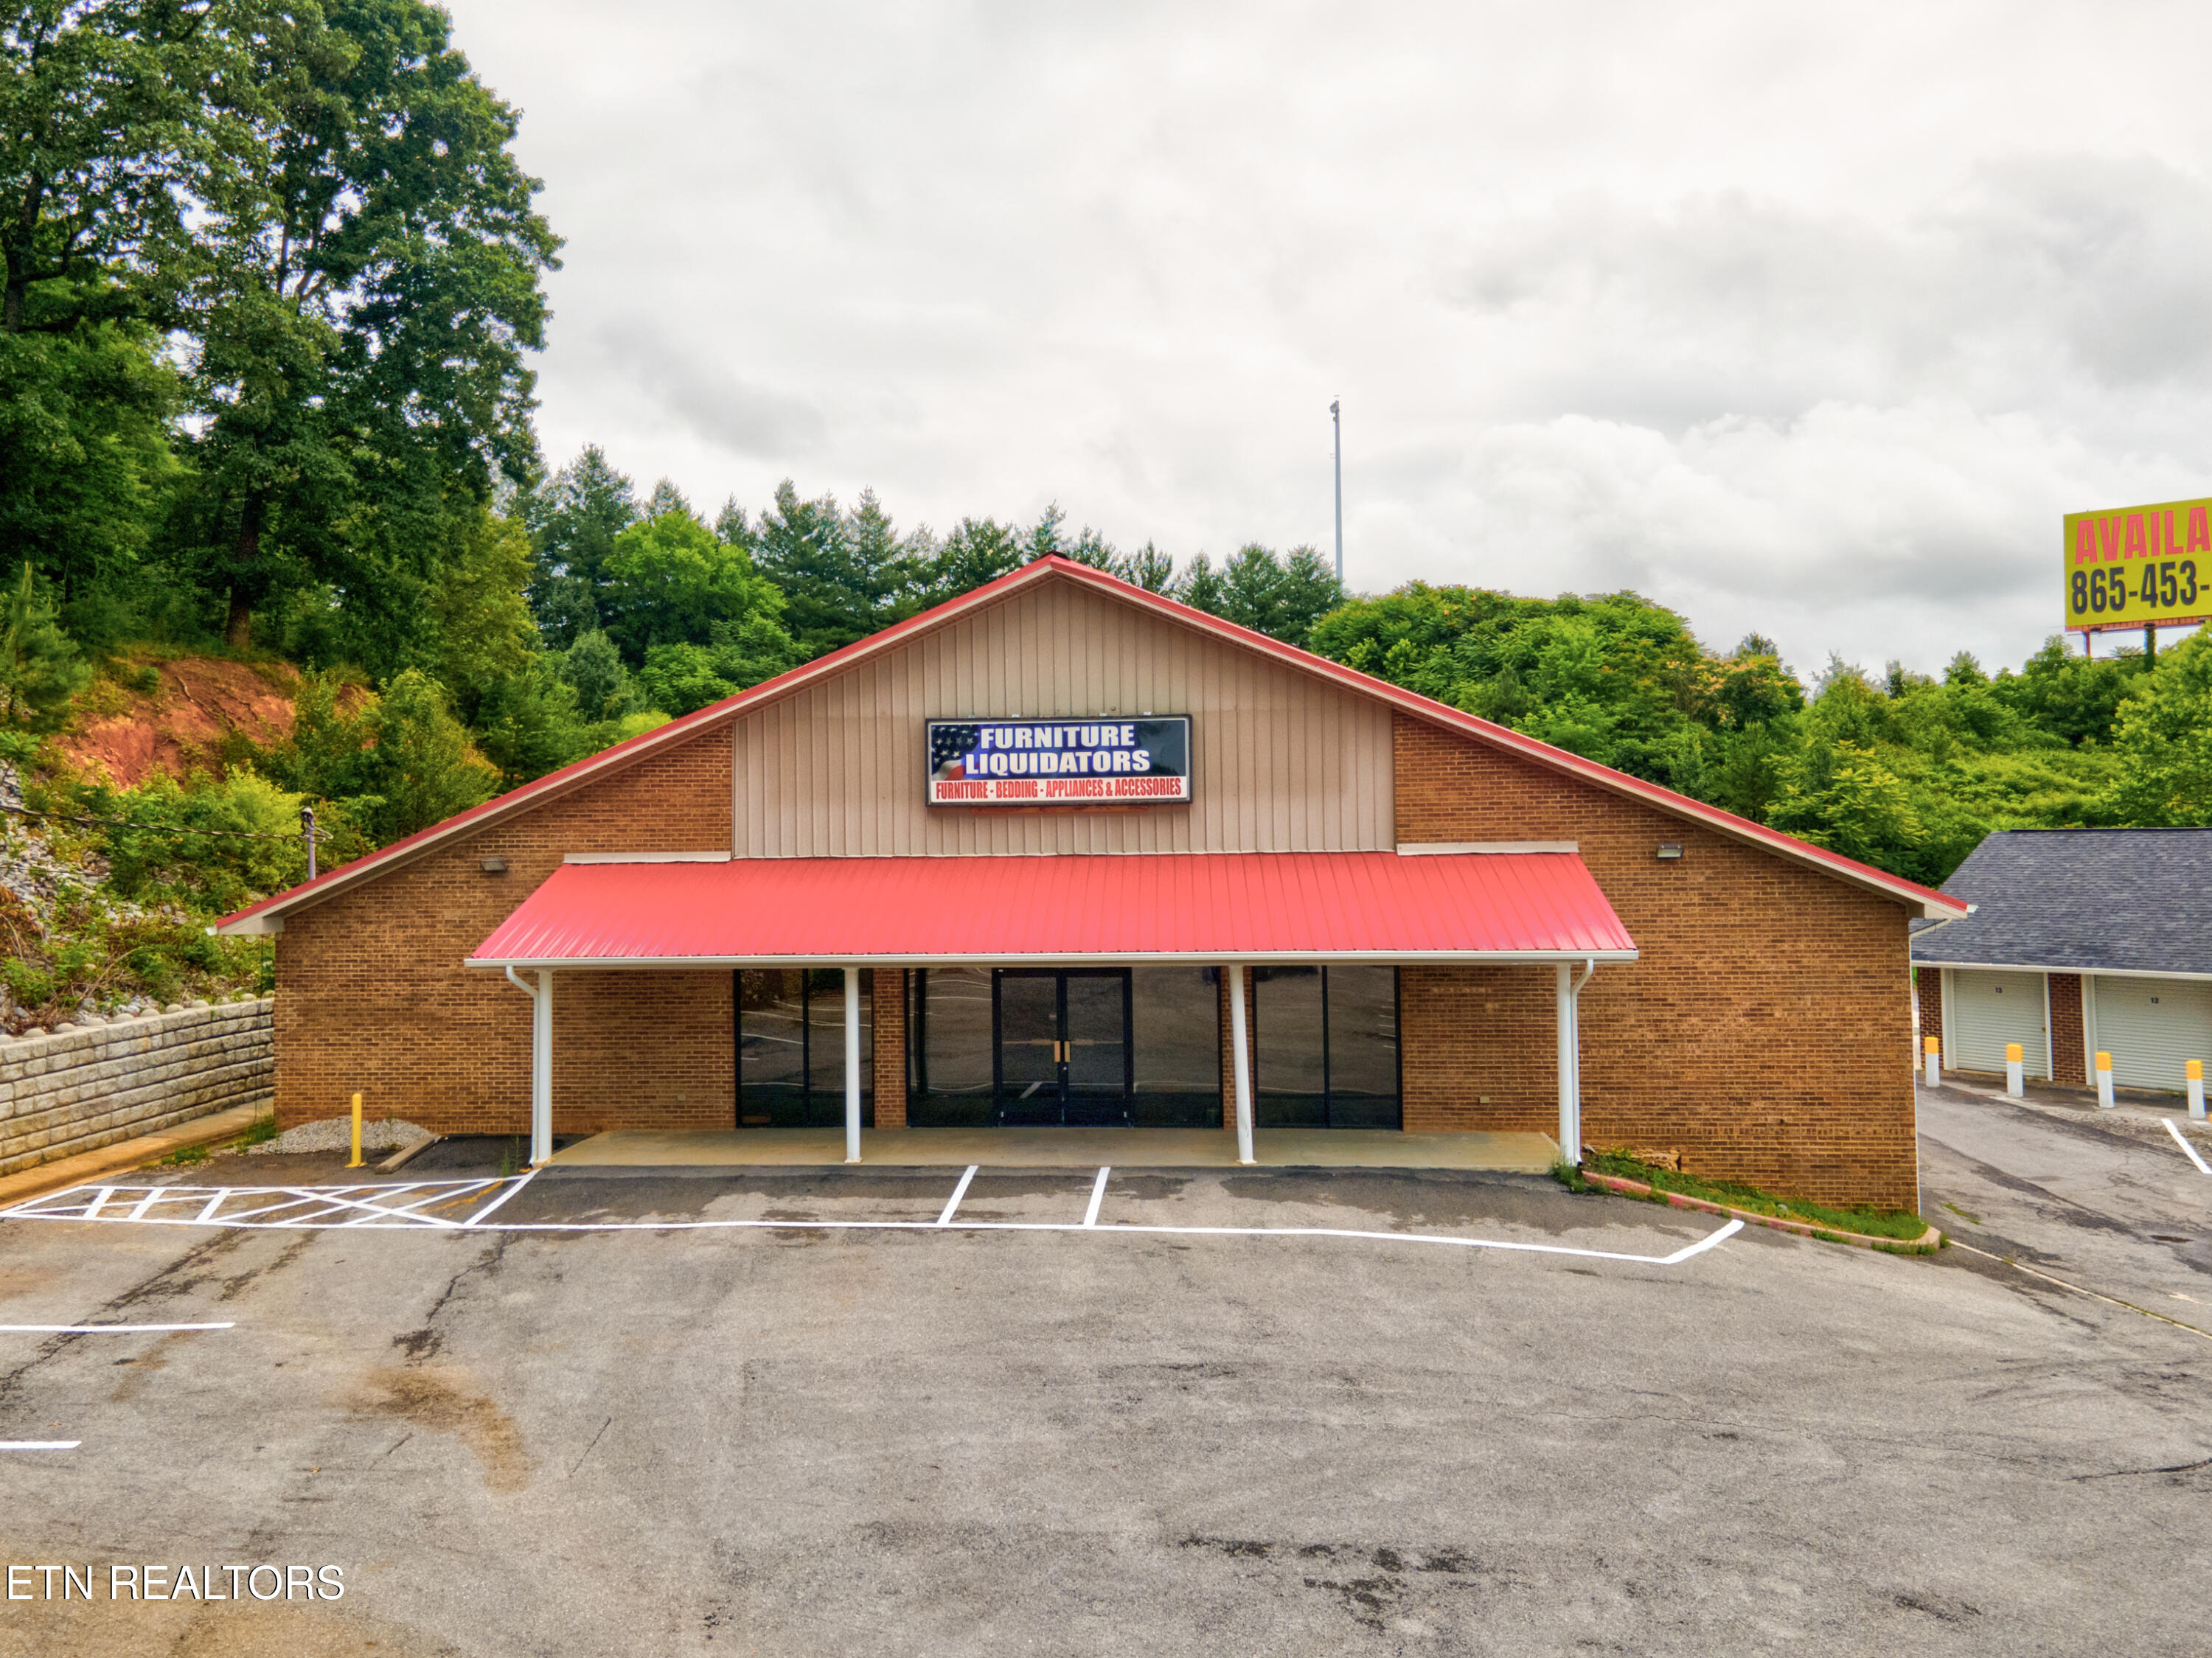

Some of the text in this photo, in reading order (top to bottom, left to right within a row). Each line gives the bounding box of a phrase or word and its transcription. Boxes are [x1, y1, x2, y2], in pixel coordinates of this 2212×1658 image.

[2075, 506, 2211, 565] AVAILA
[2071, 560, 2210, 615] 865-453-
[981, 725, 1135, 749] FURNITURE
[965, 750, 1150, 776] LIQUIDATORS
[936, 781, 988, 799] FURNITURE
[996, 781, 1038, 798] BEDDING
[1046, 779, 1104, 798] APPLIANCES
[1106, 781, 1113, 796] &
[1115, 778, 1181, 796] ACCESSORIES
